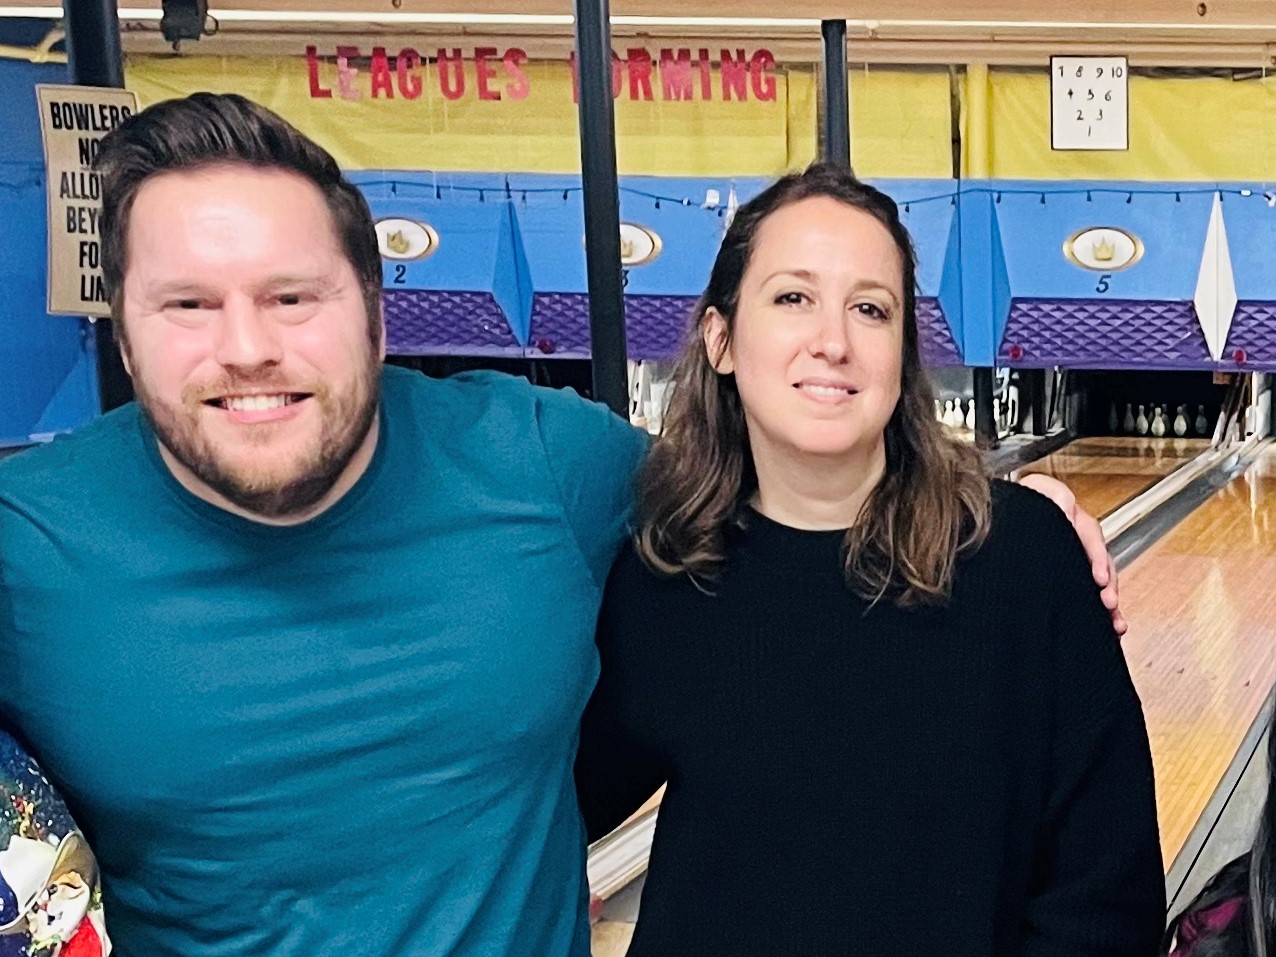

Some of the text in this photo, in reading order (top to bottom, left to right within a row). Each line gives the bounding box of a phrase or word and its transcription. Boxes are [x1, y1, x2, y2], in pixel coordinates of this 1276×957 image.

[306, 45, 777, 103] LEAGUES RMING
[1096, 67, 1104, 79] 9
[1111, 66, 1123, 78] 10
[1104, 89, 1112, 102] 6
[1076, 108, 1103, 121] 2 3
[1087, 125, 1092, 137] 1
[78, 137, 101, 166] NO
[60, 171, 103, 200] ALLO
[66, 205, 102, 235] BEY
[79, 241, 99, 270] FO
[393, 264, 407, 285] 2
[1095, 274, 1112, 293] 5
[80, 274, 108, 302] LIN
